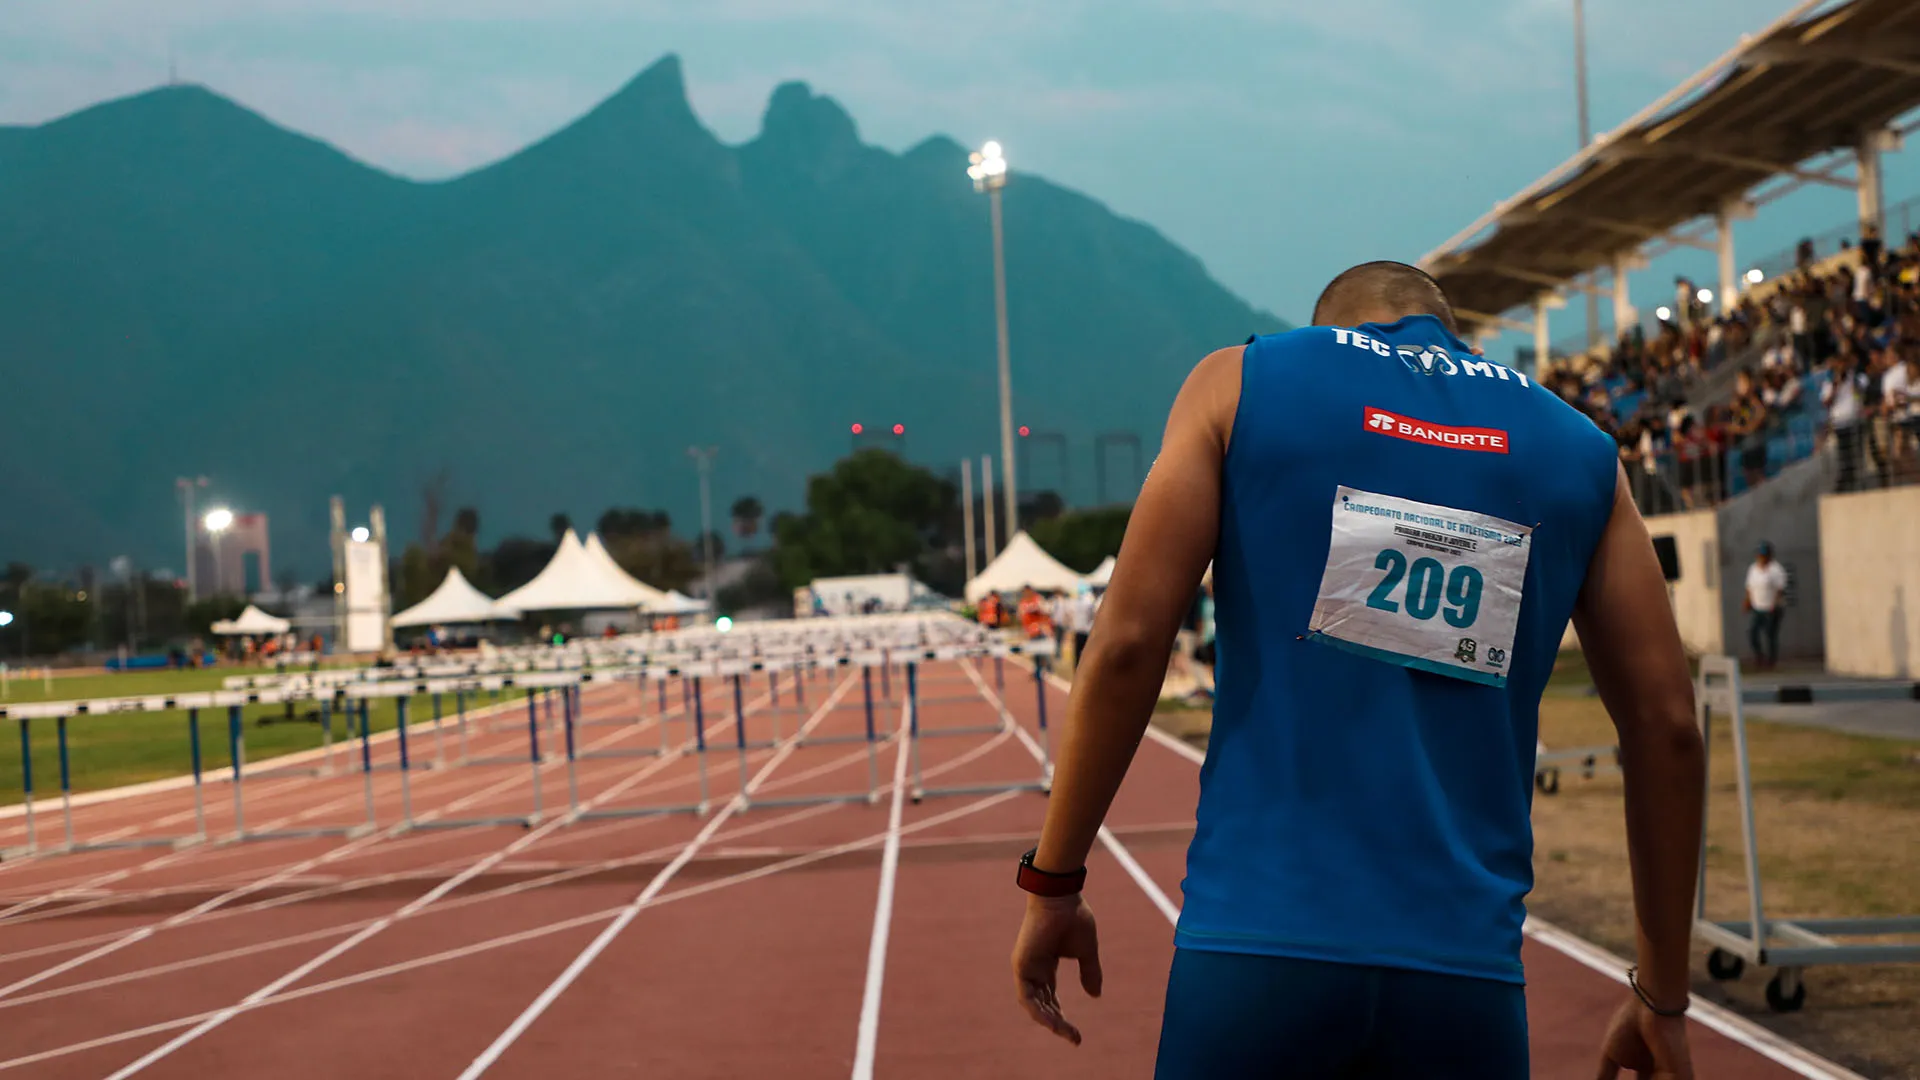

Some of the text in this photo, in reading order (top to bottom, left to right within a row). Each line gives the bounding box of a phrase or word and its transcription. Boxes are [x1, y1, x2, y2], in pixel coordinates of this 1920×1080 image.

[1331, 328, 1529, 388] TEC MTY
[1398, 422, 1504, 447] BANORTE
[1344, 502, 1402, 520] CAMPEONATO
[1404, 512, 1444, 529] NACIONAL
[1447, 520, 1457, 531] DE
[1459, 523, 1502, 542] ATLETISMO
[1366, 548, 1483, 629] 209
[1460, 640, 1475, 652] 45
